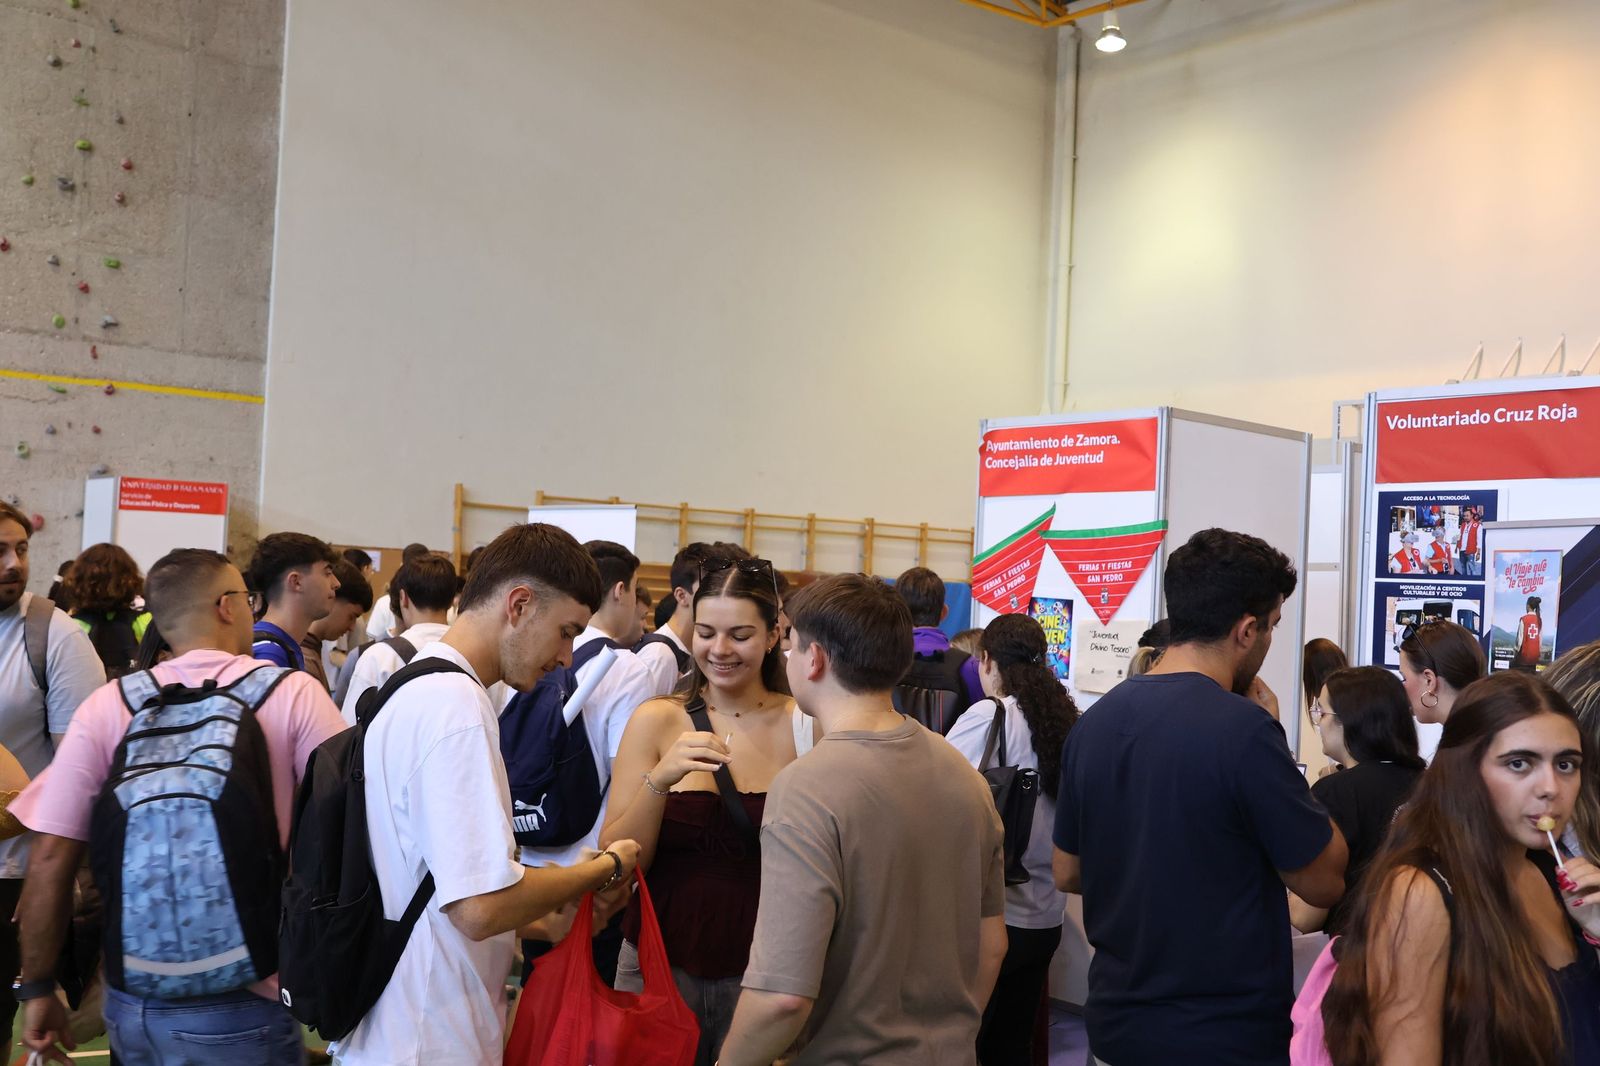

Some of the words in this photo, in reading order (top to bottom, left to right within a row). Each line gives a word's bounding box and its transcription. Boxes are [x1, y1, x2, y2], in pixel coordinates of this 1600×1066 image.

[1386, 409, 1490, 430] Voluntariado
[1494, 408, 1534, 423] Cruz
[1538, 404, 1578, 422] Roja
[986, 438, 1058, 453] Ayuntamiento
[1061, 435, 1074, 448] de
[1076, 434, 1120, 446] Zamora.
[986, 454, 1038, 470] Concejalía
[1040, 454, 1052, 466] de
[1054, 451, 1104, 465] Juventud
[120, 498, 152, 507] Educación
[174, 502, 200, 510] Deportes
[1108, 560, 1132, 570] FIESTAS
[983, 576, 1002, 592] FERIAS
[1008, 560, 1030, 577] FIESTAS
[1102, 574, 1122, 582] PEDRO
[994, 586, 1006, 598] SAN
[1007, 574, 1026, 590] PEDRO
[1038, 615, 1060, 628] CINE
[1045, 630, 1066, 644] VEN
[513, 814, 540, 832] MA
